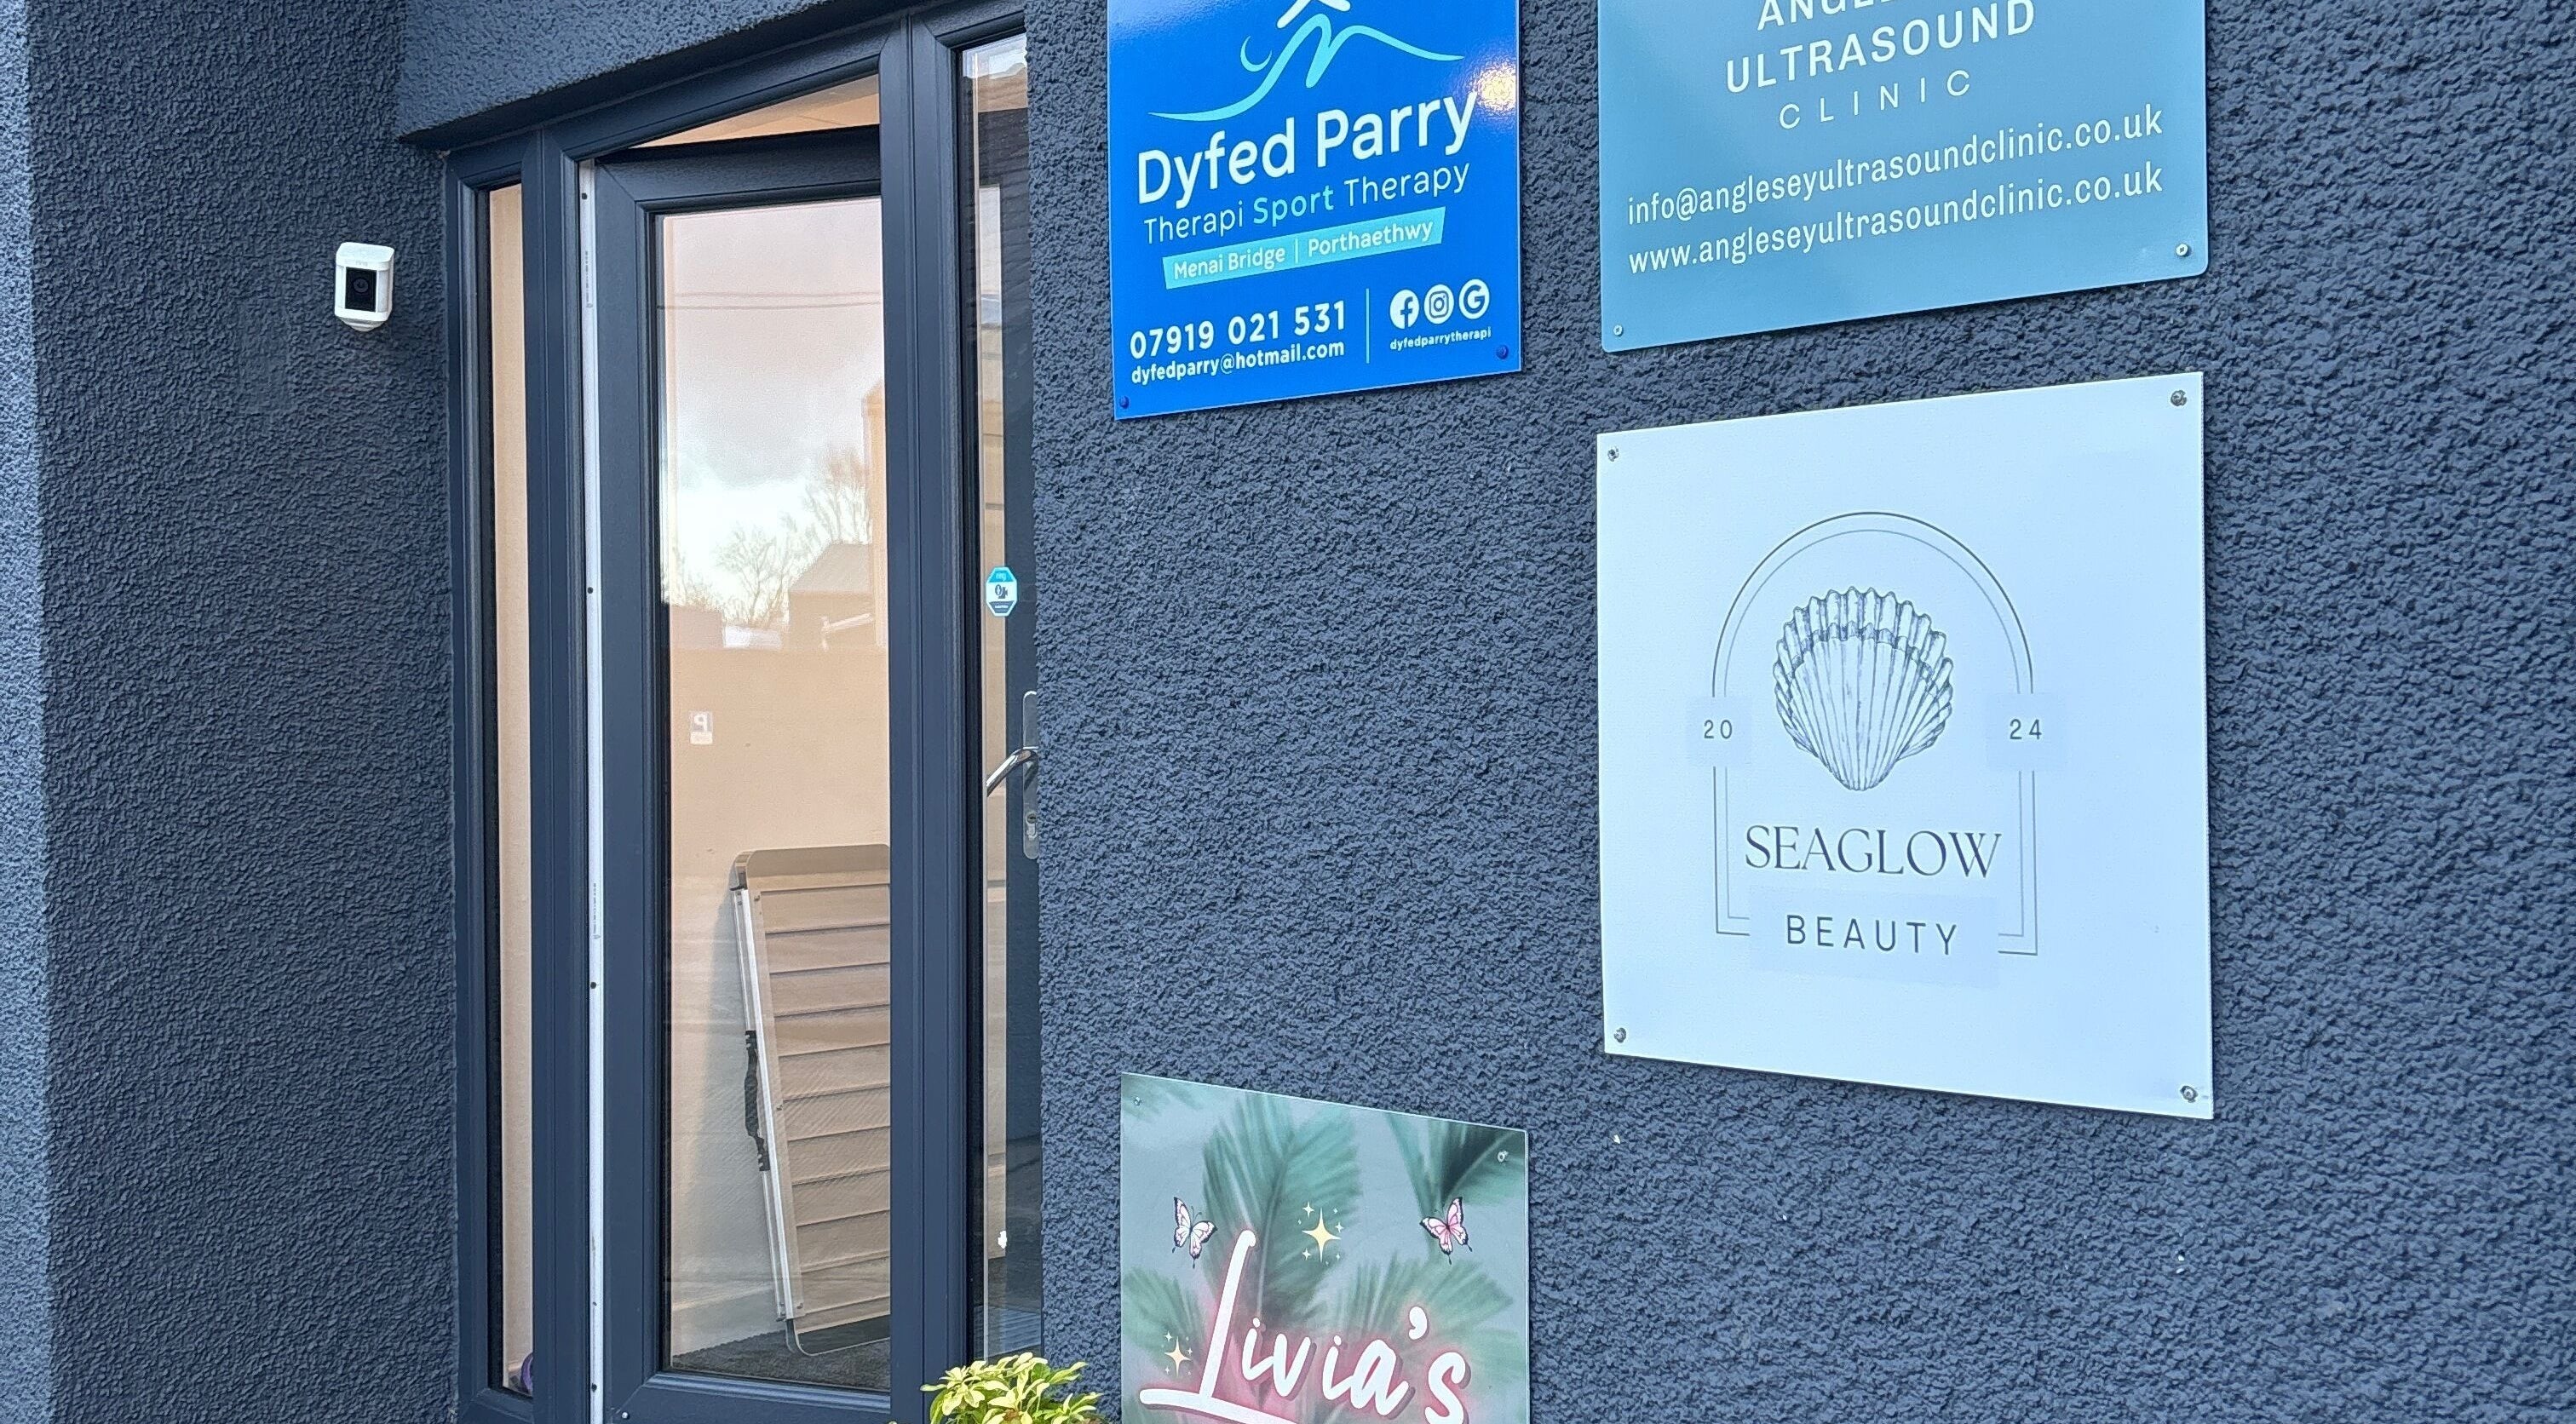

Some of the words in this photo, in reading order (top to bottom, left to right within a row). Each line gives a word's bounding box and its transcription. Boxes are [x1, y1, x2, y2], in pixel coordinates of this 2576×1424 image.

[1726, 0, 2035, 94] ULTRASOUND
[1779, 70, 1972, 130] CLINIC
[1137, 117, 1296, 210] Dyfed
[1316, 90, 1477, 169] Parry
[1627, 103, 2164, 226] info@angleseyultrasoundclinic.co.uk
[1143, 200, 1244, 245] Therapi
[1253, 185, 1335, 227] Sport
[1344, 162, 1470, 205] Therapy
[1628, 160, 2164, 274] www.angleseyultrasoundclinic.co.uk
[1173, 259, 1224, 281] Menai
[1228, 244, 1286, 273] Bridge
[1308, 218, 1435, 257] Porthaethwy
[1130, 320, 1215, 359] 07919
[1228, 310, 1280, 346] 021
[1294, 300, 1346, 336] 531
[1389, 326, 1492, 352] dyfedparrytherapi
[1131, 341, 1346, 386] dyfedparry@hotmail.com
[1703, 719, 1733, 741] 20
[2009, 719, 2043, 742] 24
[1744, 824, 2003, 879] SEAGLOW
[1785, 914, 1958, 956] BEAUTY
[1139, 1229, 1470, 1424] Livia's
